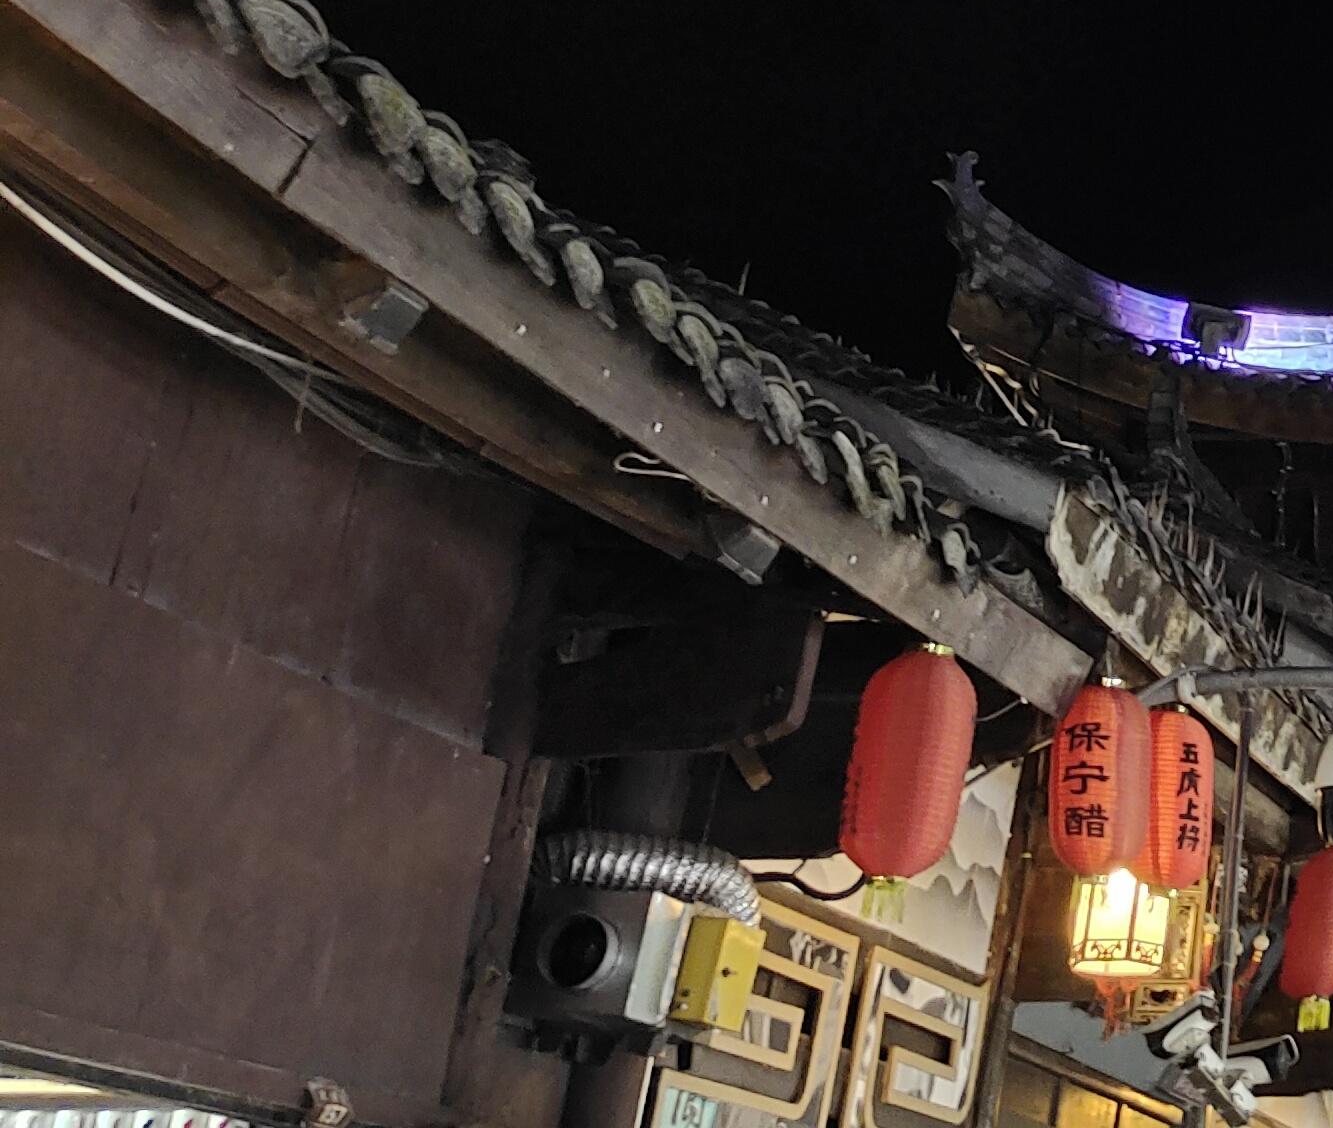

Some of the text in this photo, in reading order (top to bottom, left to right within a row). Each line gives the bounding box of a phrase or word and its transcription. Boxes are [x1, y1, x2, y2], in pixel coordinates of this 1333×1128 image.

[1062, 721, 1111, 838] 保宁醋
[1177, 741, 1202, 852] 五虎上将
